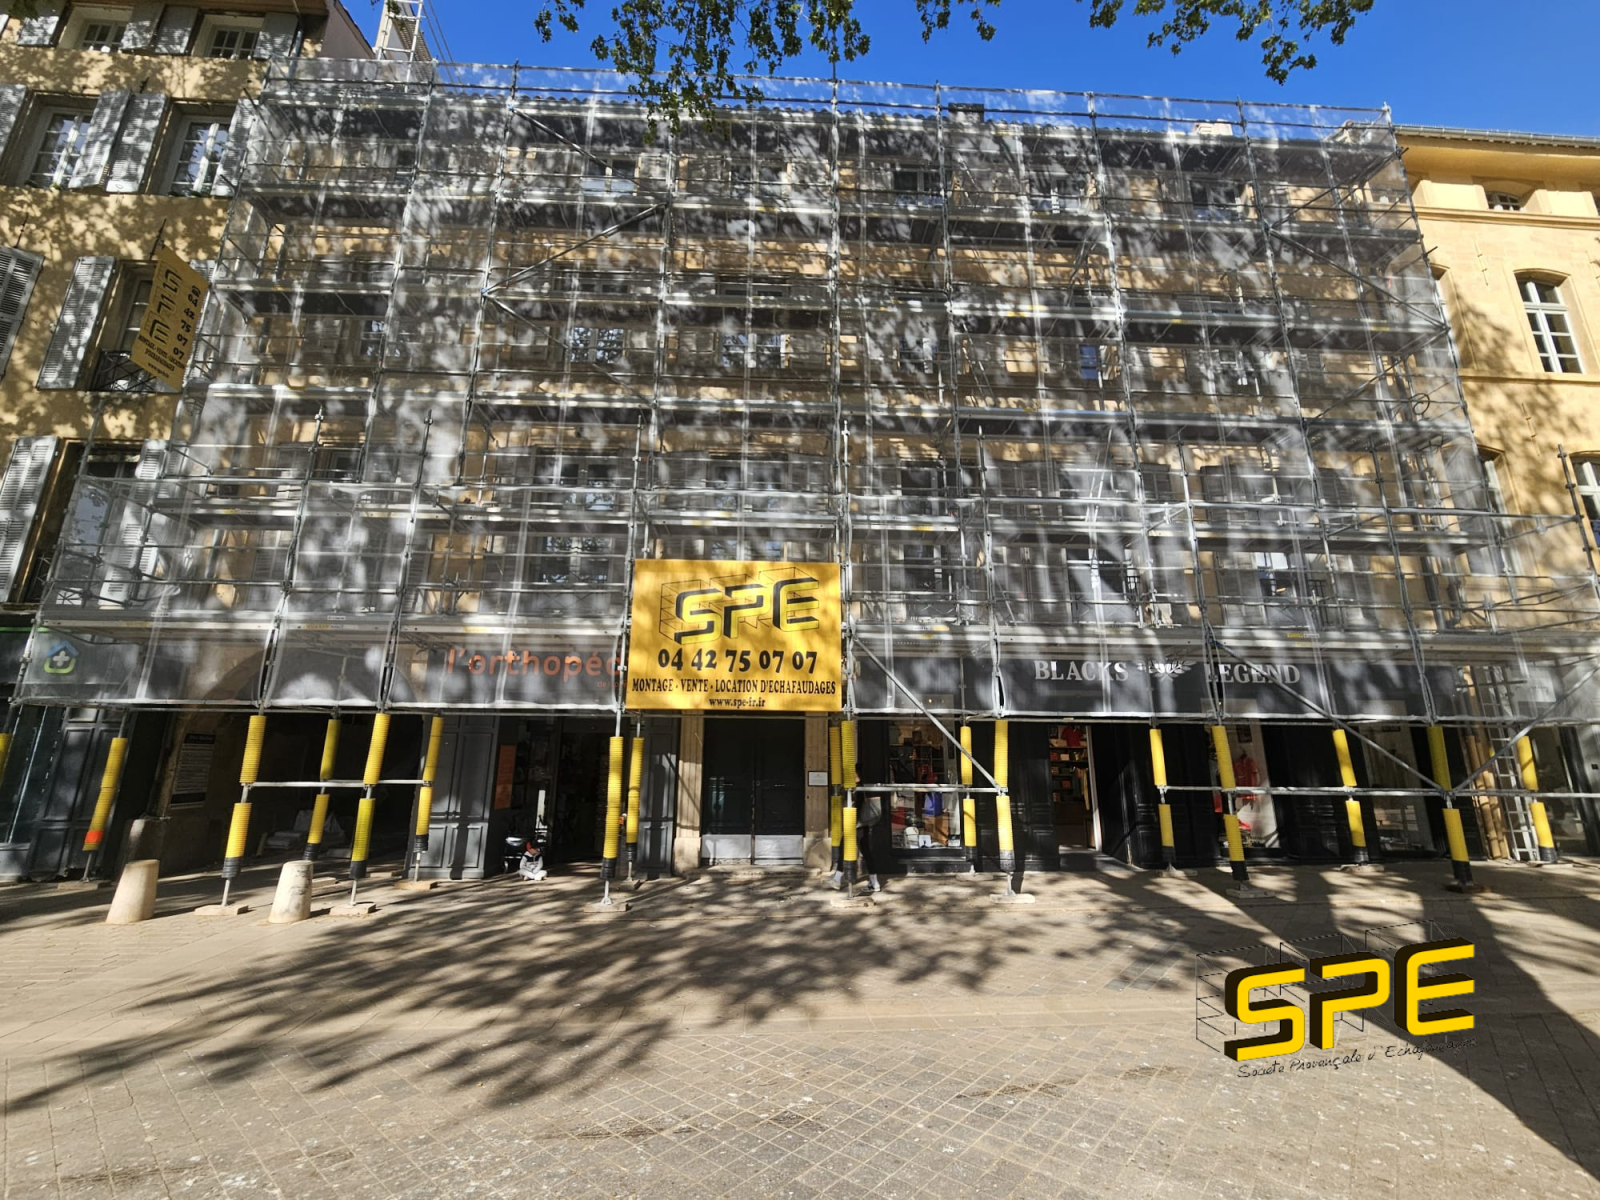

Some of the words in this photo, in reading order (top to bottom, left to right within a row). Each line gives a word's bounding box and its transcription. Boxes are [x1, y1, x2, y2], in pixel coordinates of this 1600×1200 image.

[149, 269, 183, 346] SPE
[184, 308, 195, 320] 42
[180, 319, 192, 333] 75
[176, 333, 188, 347] 07
[173, 346, 185, 360] 07
[674, 576, 820, 645] SPE
[658, 648, 683, 671] 04
[691, 648, 717, 671] 42
[725, 649, 751, 673] 75
[759, 650, 784, 674] 07
[792, 651, 818, 675] 07
[1034, 659, 1129, 682] BLACKS
[632, 678, 673, 692] MONTAGE
[681, 679, 709, 692] VENTE
[715, 679, 758, 693] LOCATION
[760, 680, 836, 695] D'ECHAFAUDAGES
